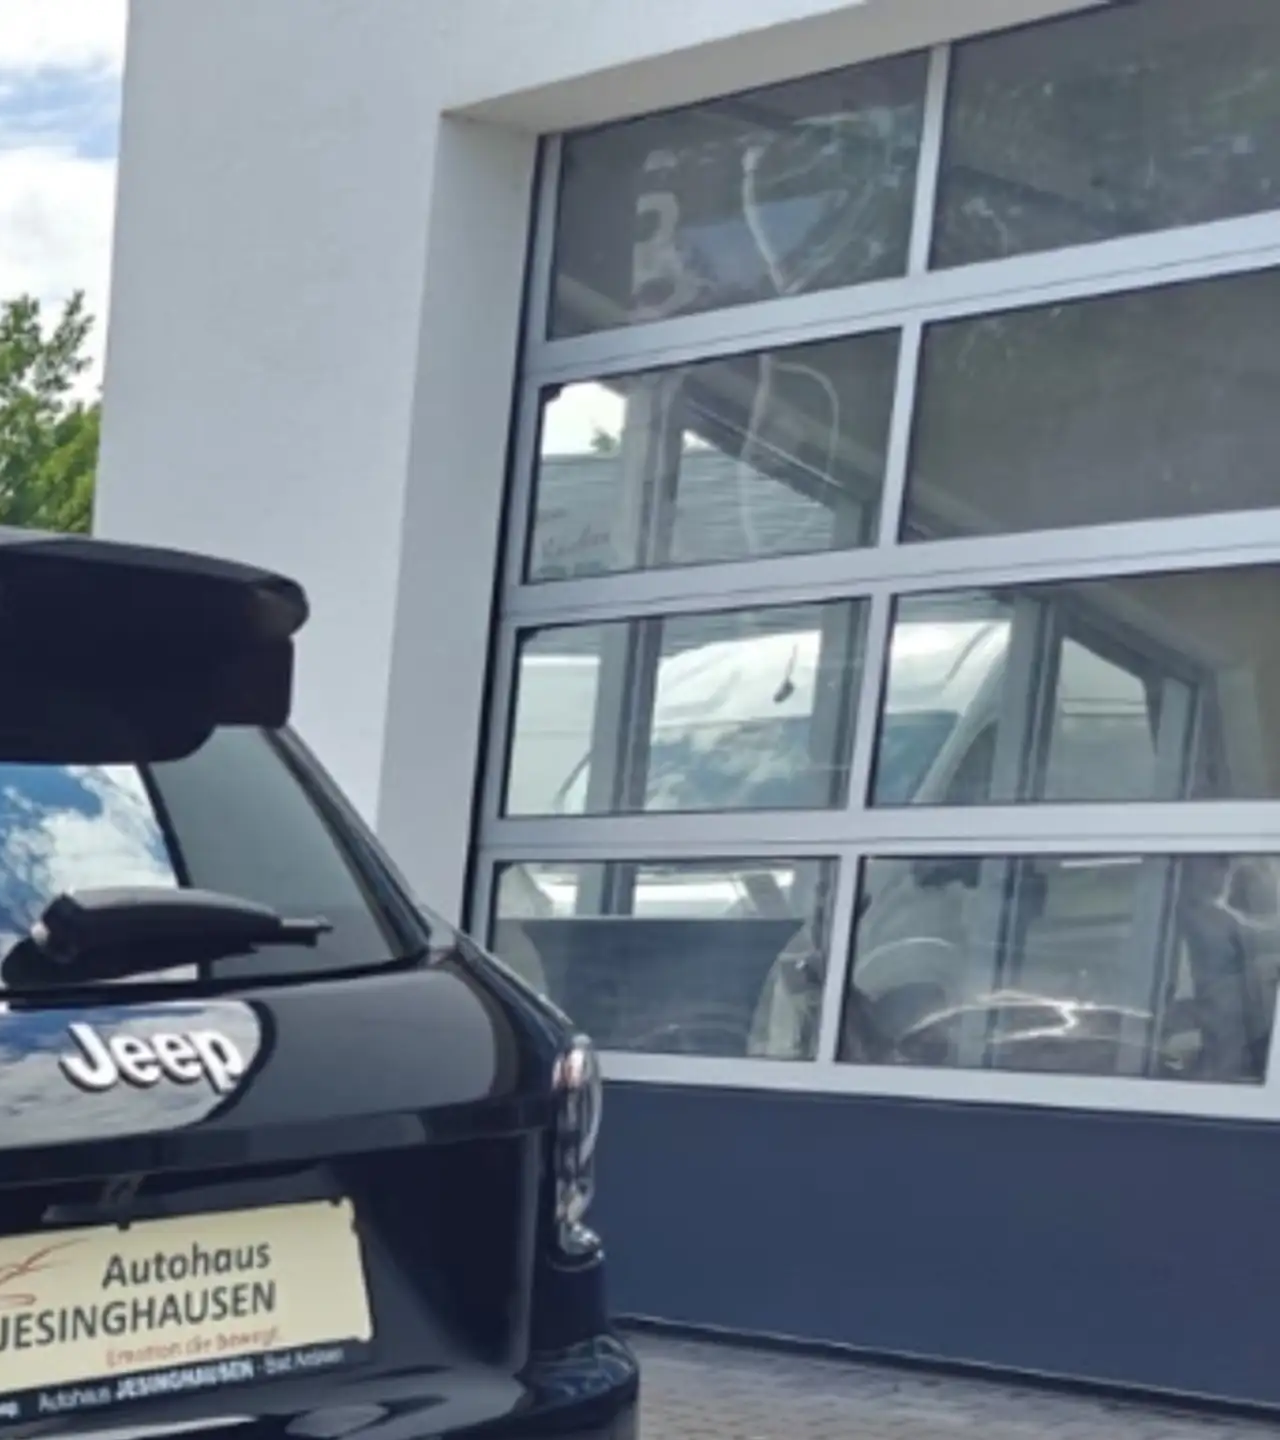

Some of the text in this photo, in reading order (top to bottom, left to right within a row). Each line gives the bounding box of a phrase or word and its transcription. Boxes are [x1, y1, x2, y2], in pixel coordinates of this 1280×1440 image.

[59, 1022, 244, 1094] Jeep
[101, 1242, 271, 1289] Autohaus
[115, 1358, 255, 1400] JESINGHAUSEN
